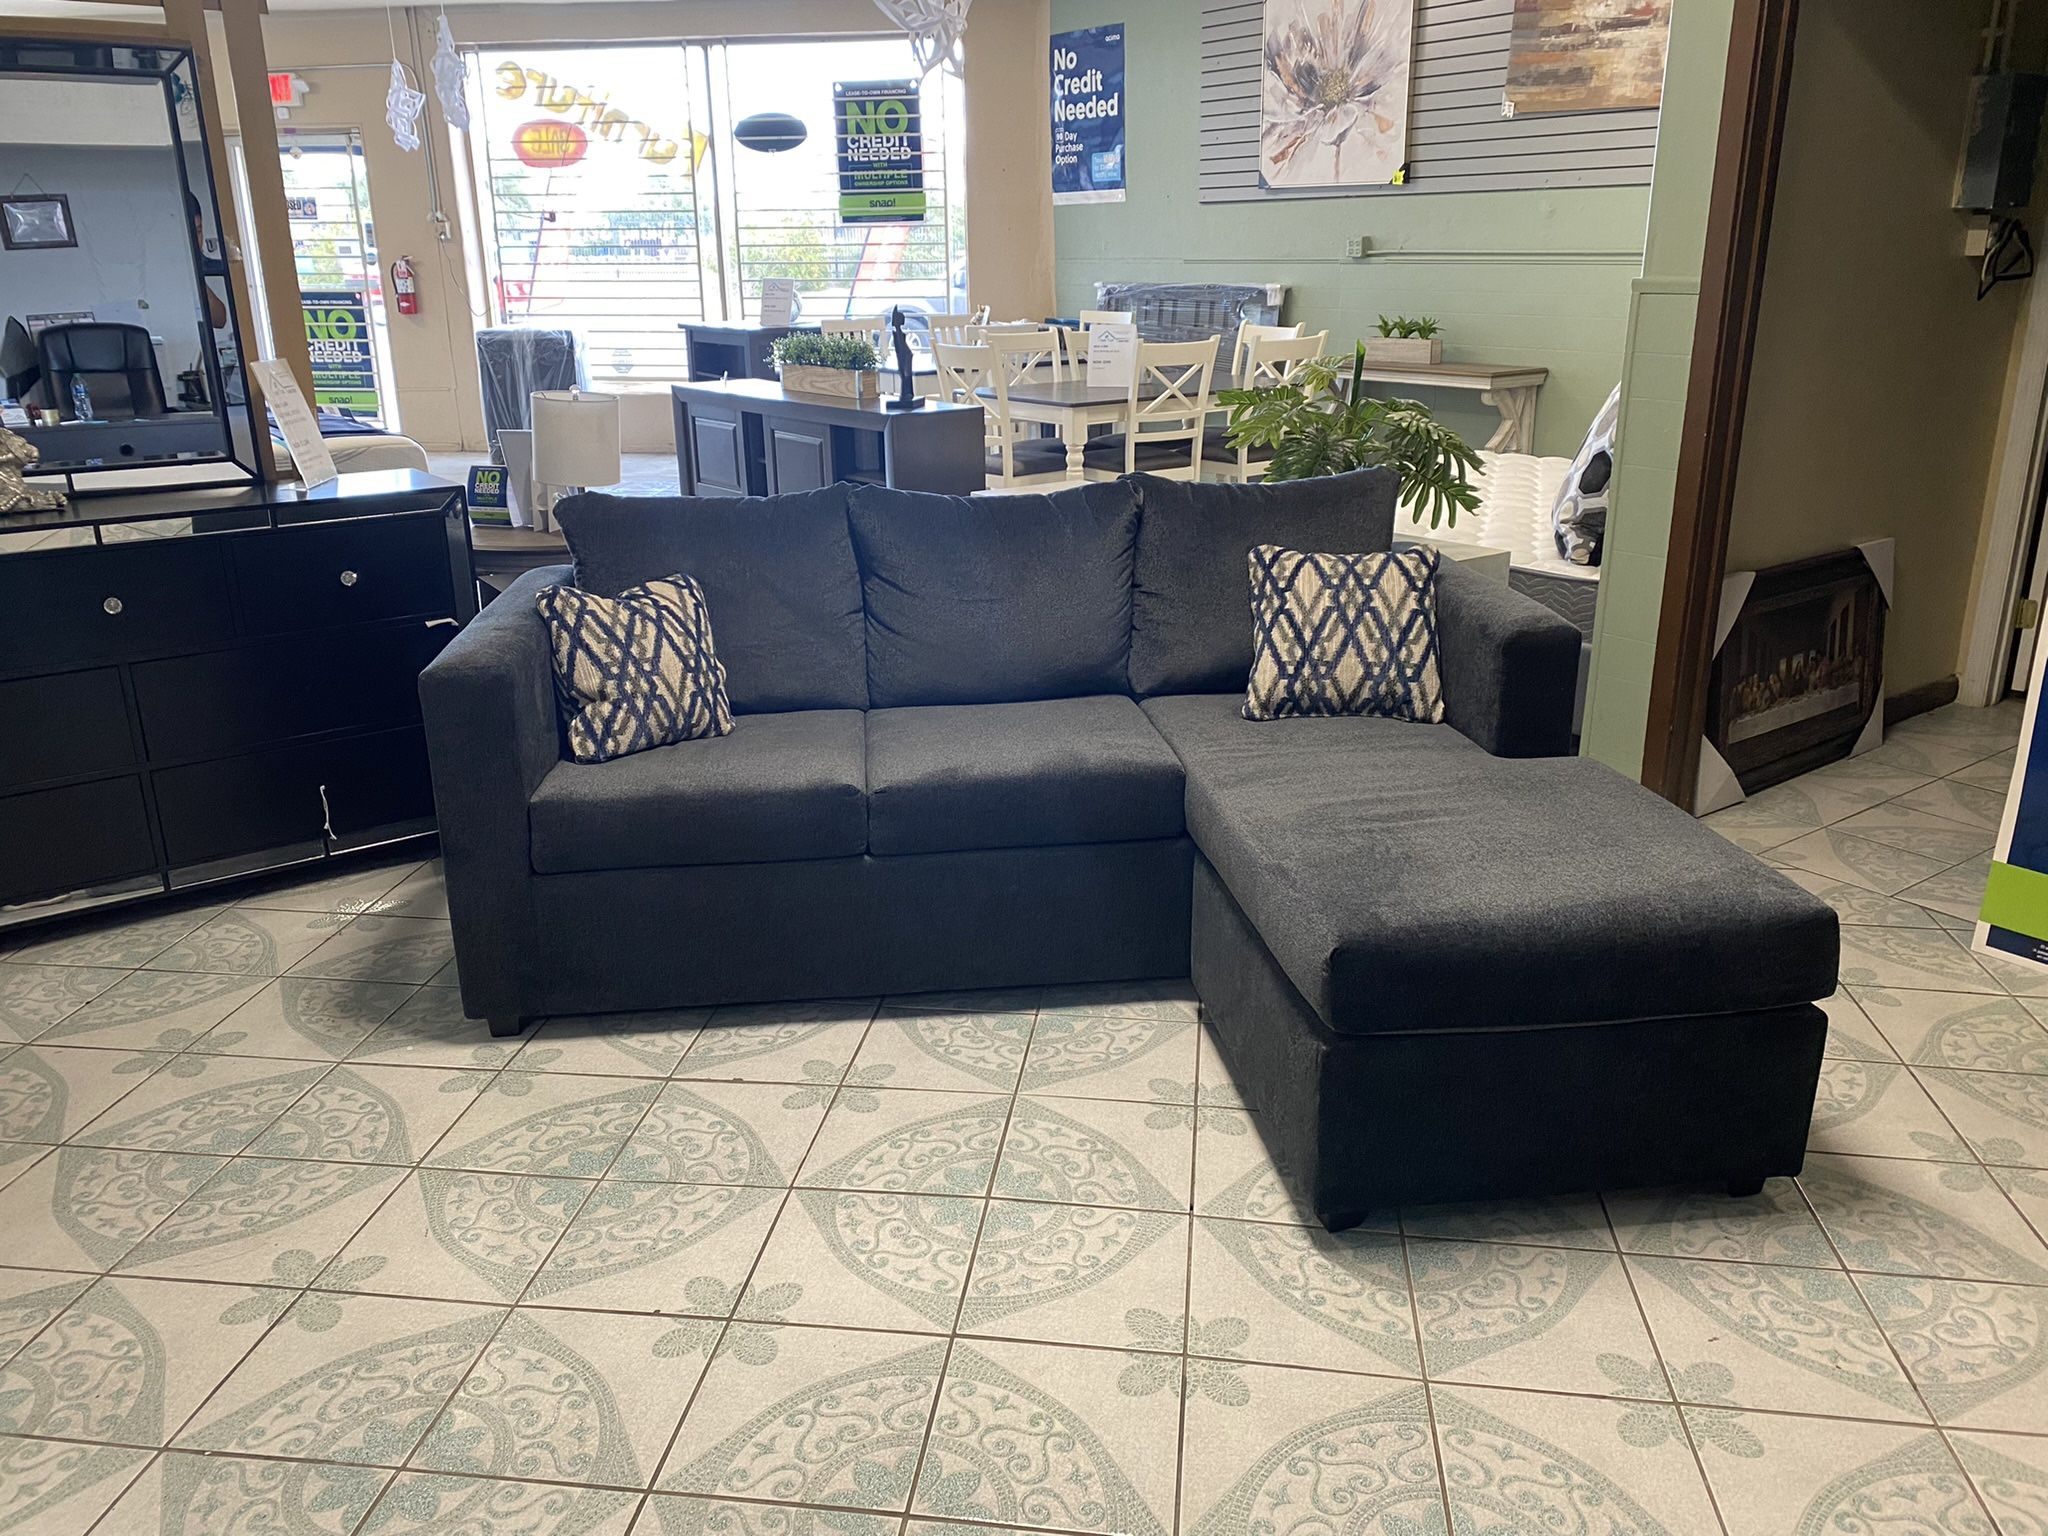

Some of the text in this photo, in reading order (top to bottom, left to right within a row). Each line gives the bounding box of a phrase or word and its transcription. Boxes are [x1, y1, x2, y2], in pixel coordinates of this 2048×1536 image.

[1054, 48, 1077, 71] No
[1054, 69, 1103, 96] Credit
[1055, 92, 1119, 122] Needed
[845, 99, 909, 135] NO
[846, 133, 909, 149] CREDIT
[1064, 131, 1078, 142] Day
[847, 146, 912, 161] NEEDED
[1055, 143, 1084, 153] Purchase
[1055, 154, 1078, 166] Option
[303, 308, 357, 341] NO
[476, 471, 501, 484] NO
